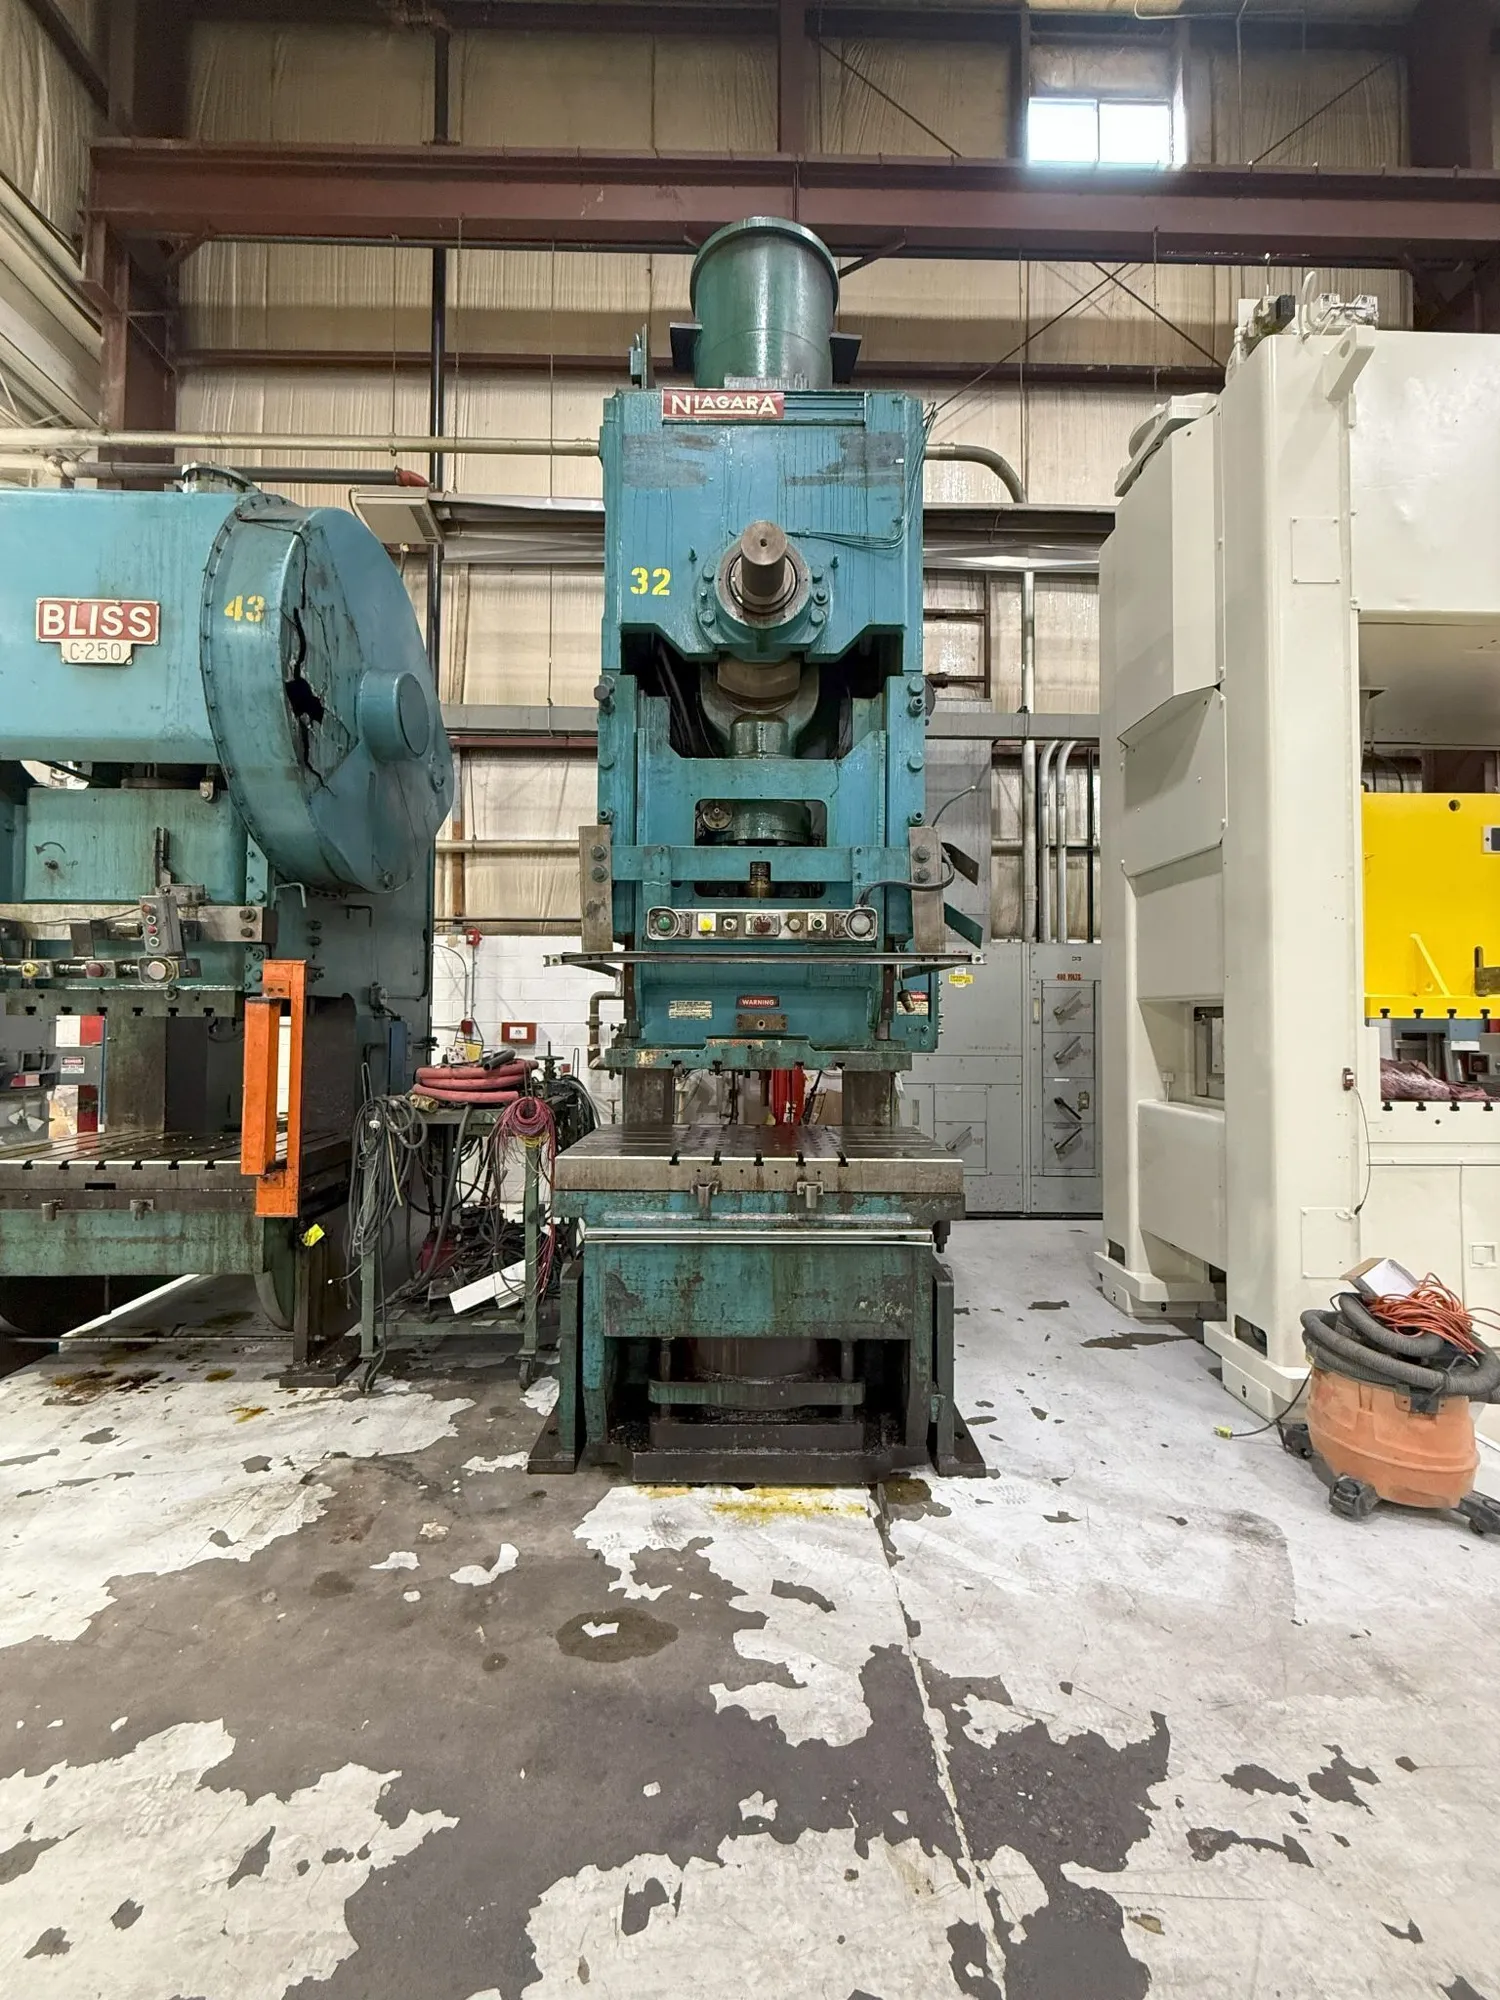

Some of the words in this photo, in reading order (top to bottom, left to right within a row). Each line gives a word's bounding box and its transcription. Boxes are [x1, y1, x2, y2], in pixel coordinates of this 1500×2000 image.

[671, 395, 778, 415] NIAGARA
[630, 567, 671, 596] 32
[42, 603, 152, 638] BLISS
[223, 595, 265, 622] 43
[69, 642, 122, 661] C-250
